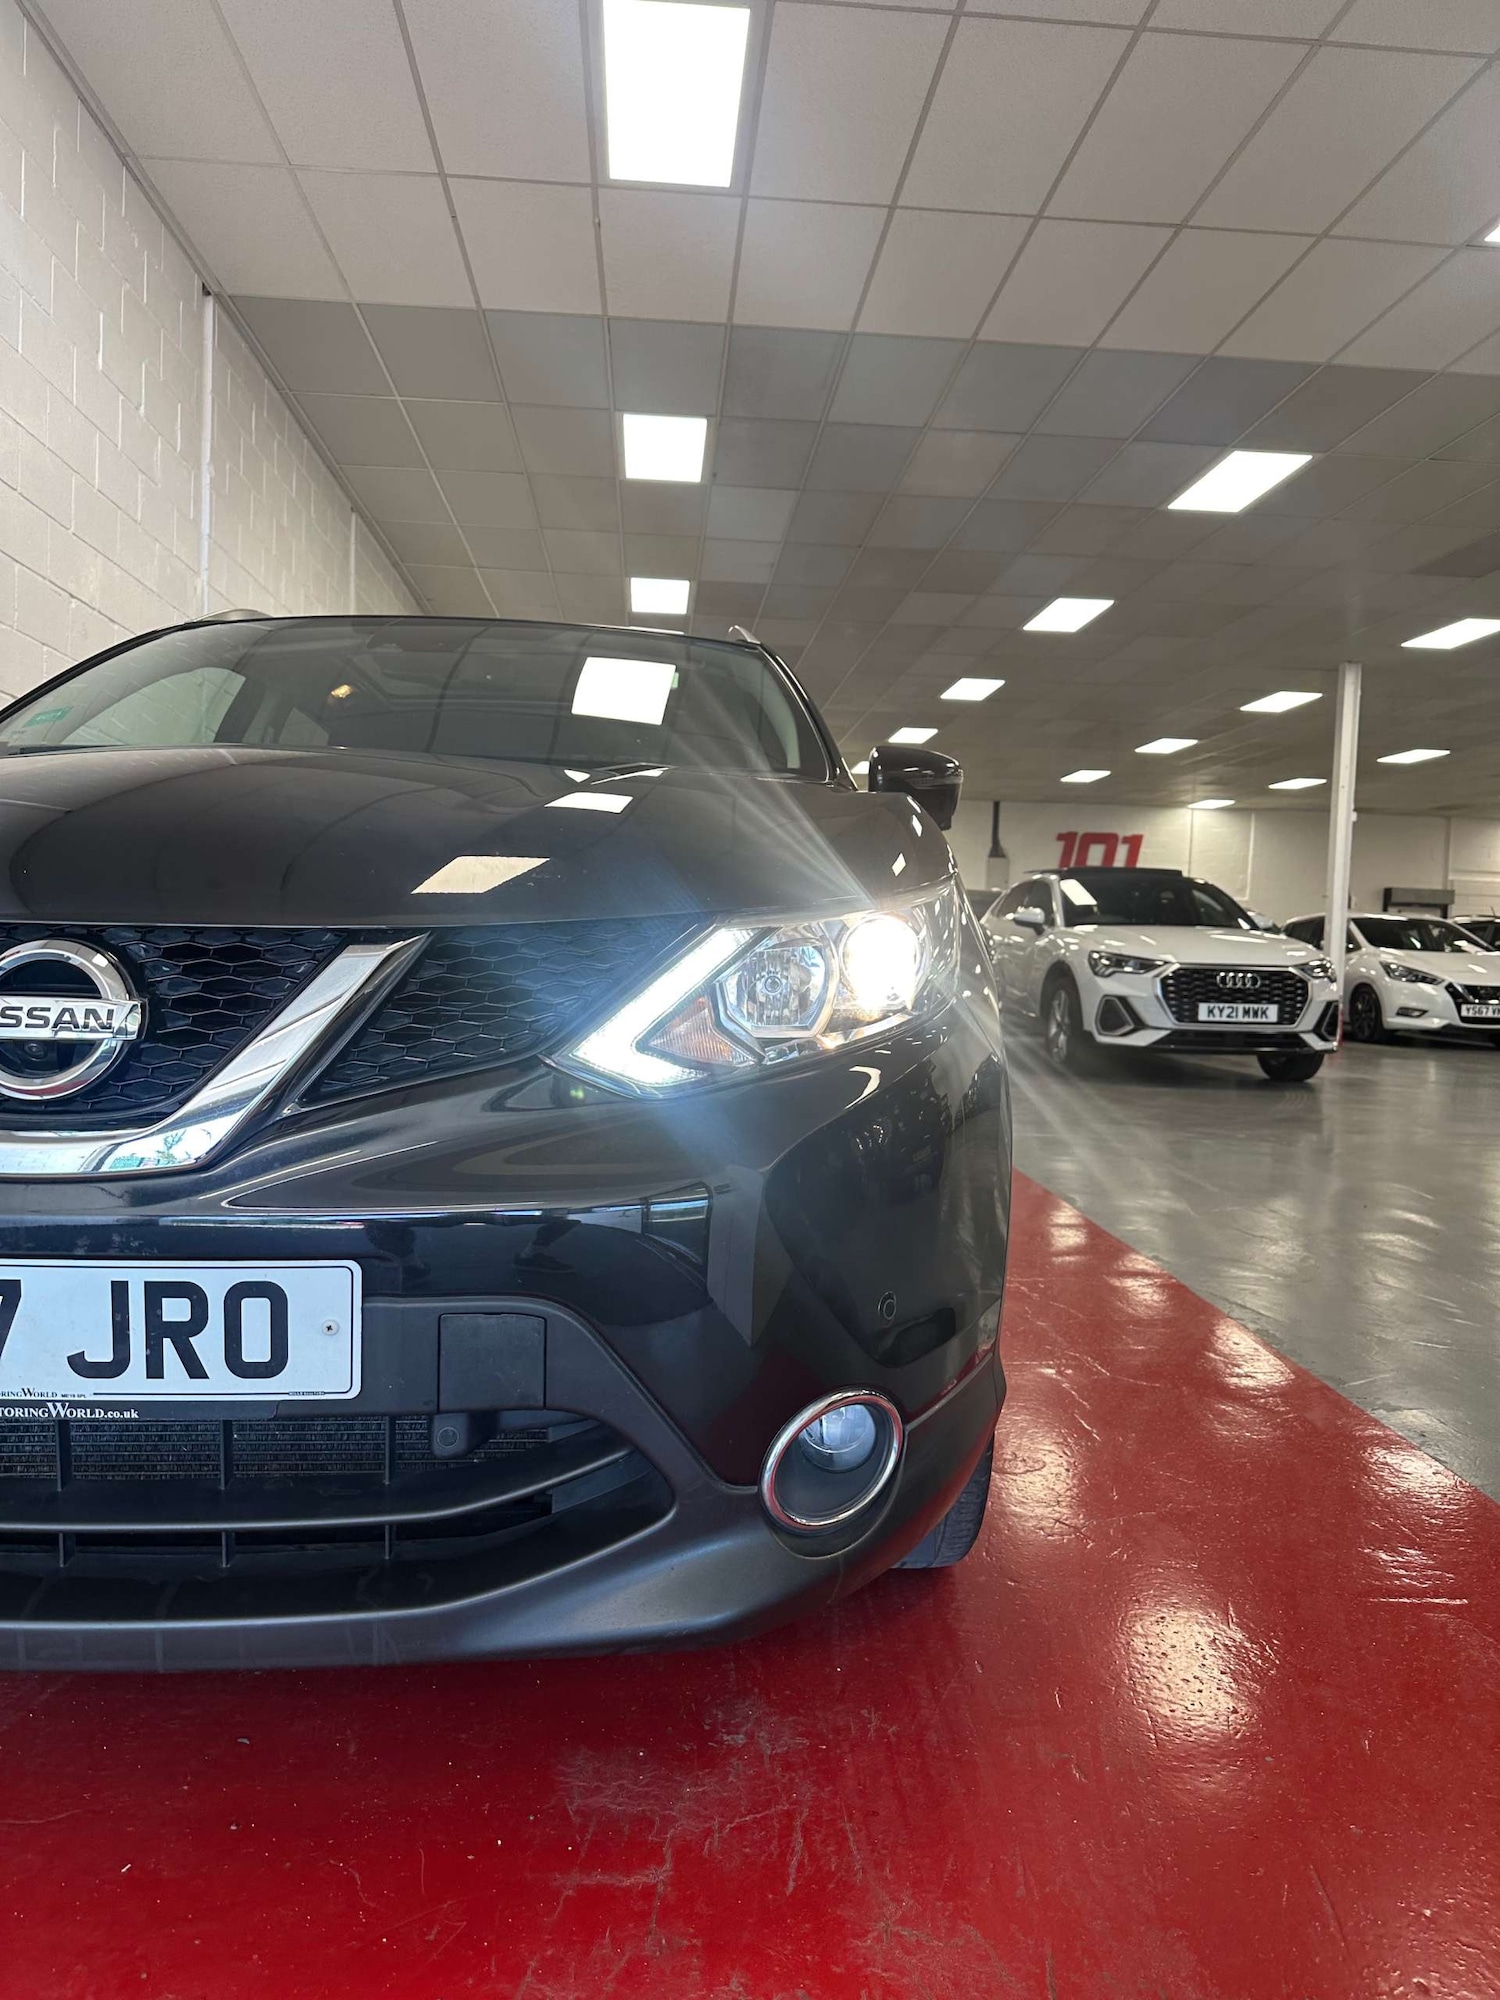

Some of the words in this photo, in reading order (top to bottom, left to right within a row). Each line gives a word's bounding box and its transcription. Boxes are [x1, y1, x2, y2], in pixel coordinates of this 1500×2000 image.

[1056, 831, 1144, 868] 101
[1207, 1005, 1238, 1019] KY21
[1242, 1006, 1269, 1019] MWK
[1465, 1005, 1489, 1016] YS67
[67, 1280, 289, 1379] JRO
[0, 1387, 57, 1398] RINGWORLD
